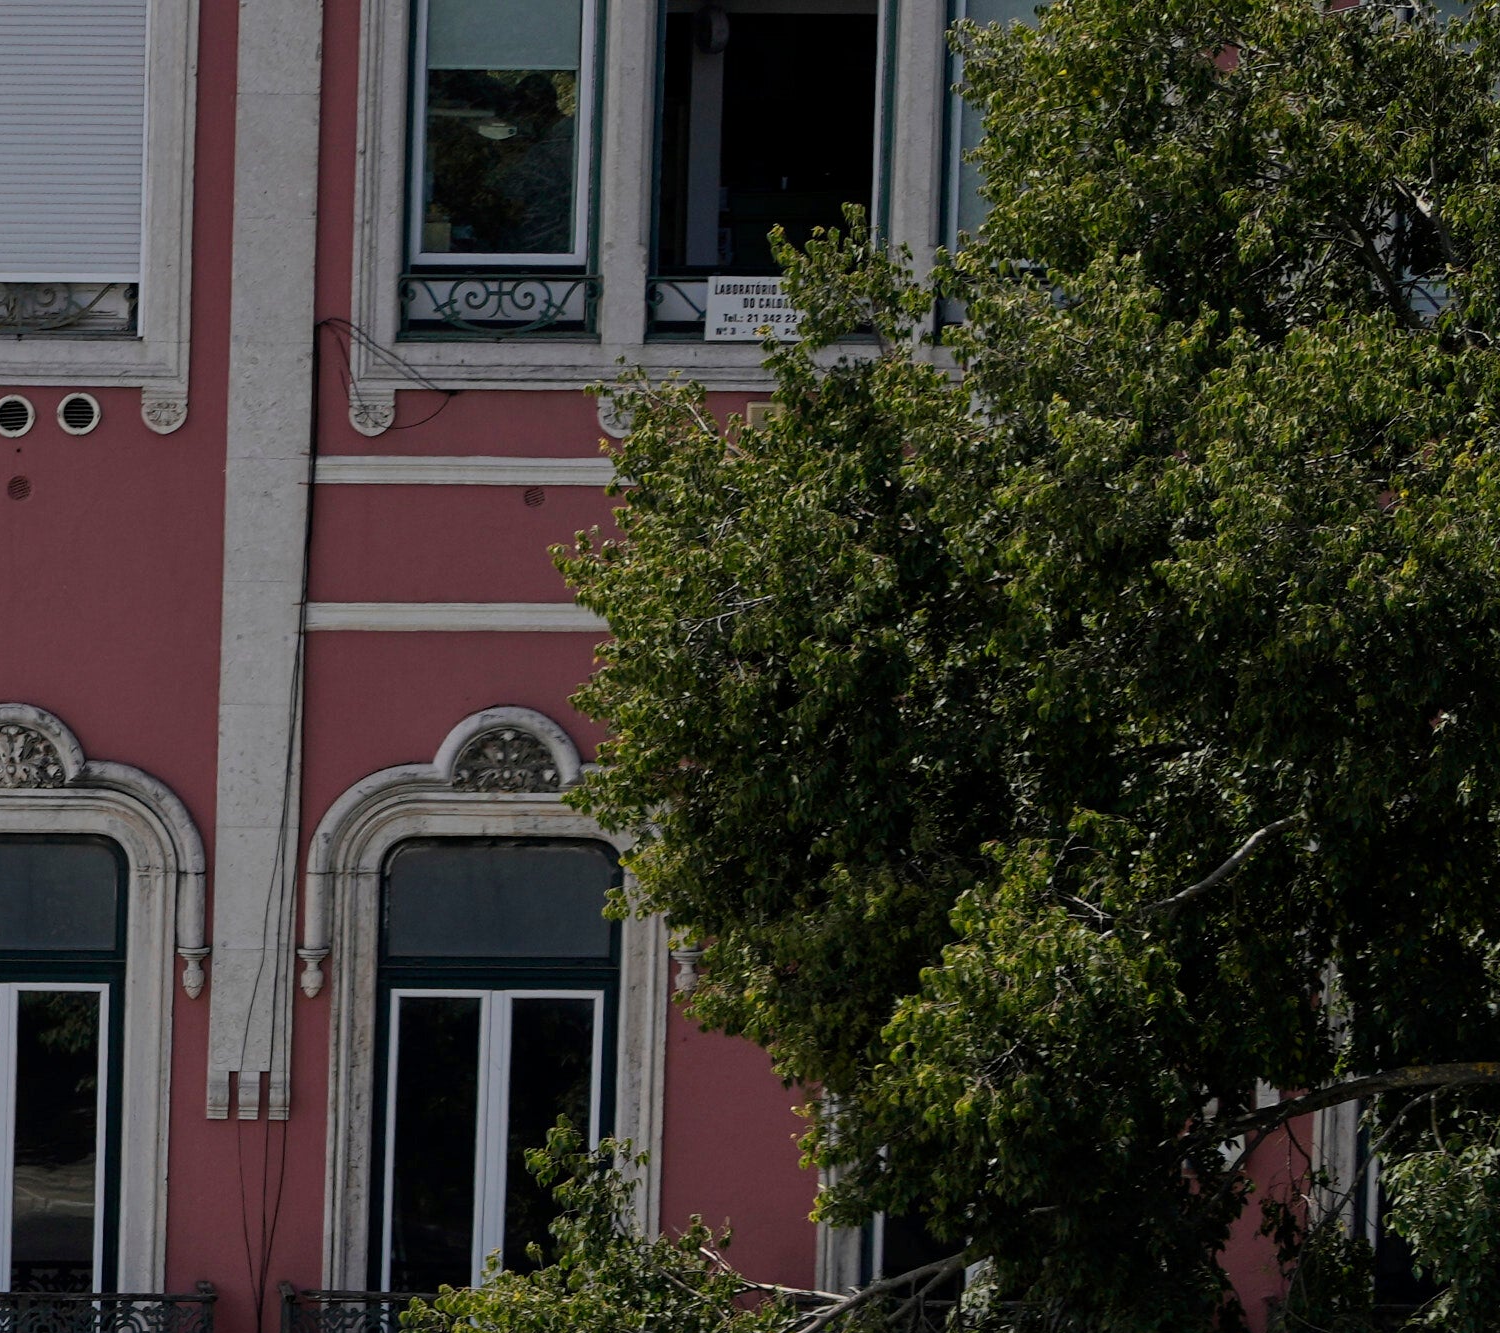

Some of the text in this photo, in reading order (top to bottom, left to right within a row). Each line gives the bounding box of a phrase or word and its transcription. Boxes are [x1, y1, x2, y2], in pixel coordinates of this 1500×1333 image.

[715, 282, 777, 296] LABORATÓRIO
[743, 298, 755, 309] DO
[747, 313, 760, 323] 21
[763, 313, 781, 323] 342
